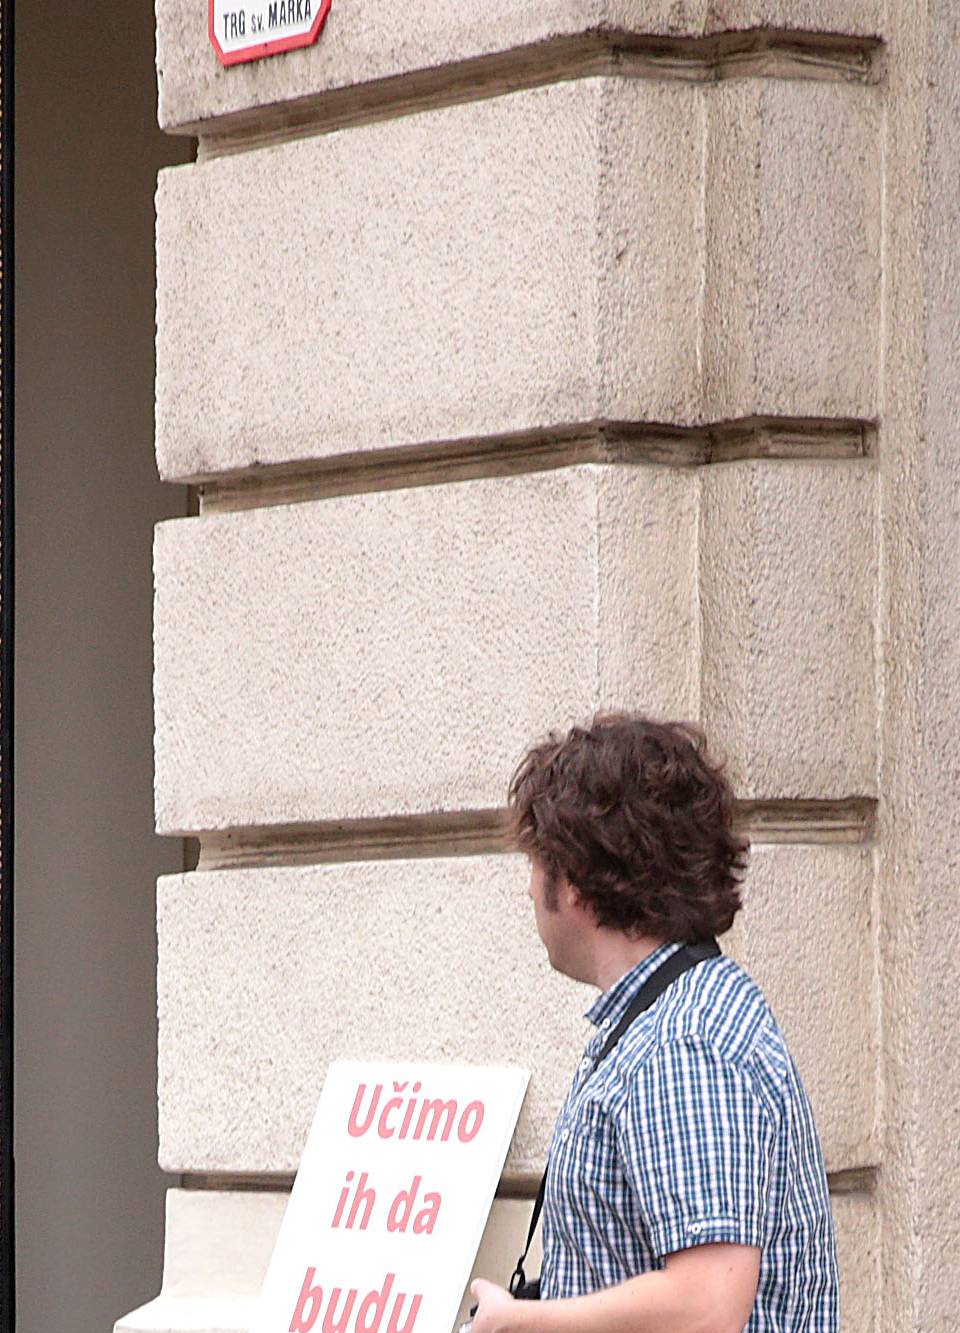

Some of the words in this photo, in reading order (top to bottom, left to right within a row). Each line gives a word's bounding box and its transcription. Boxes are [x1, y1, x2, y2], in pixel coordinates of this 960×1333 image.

[223, 9, 246, 40] TRG
[268, 0, 311, 29] MARKA
[347, 1081, 485, 1143] Učimo
[331, 1171, 376, 1230] ih
[387, 1175, 442, 1235] da
